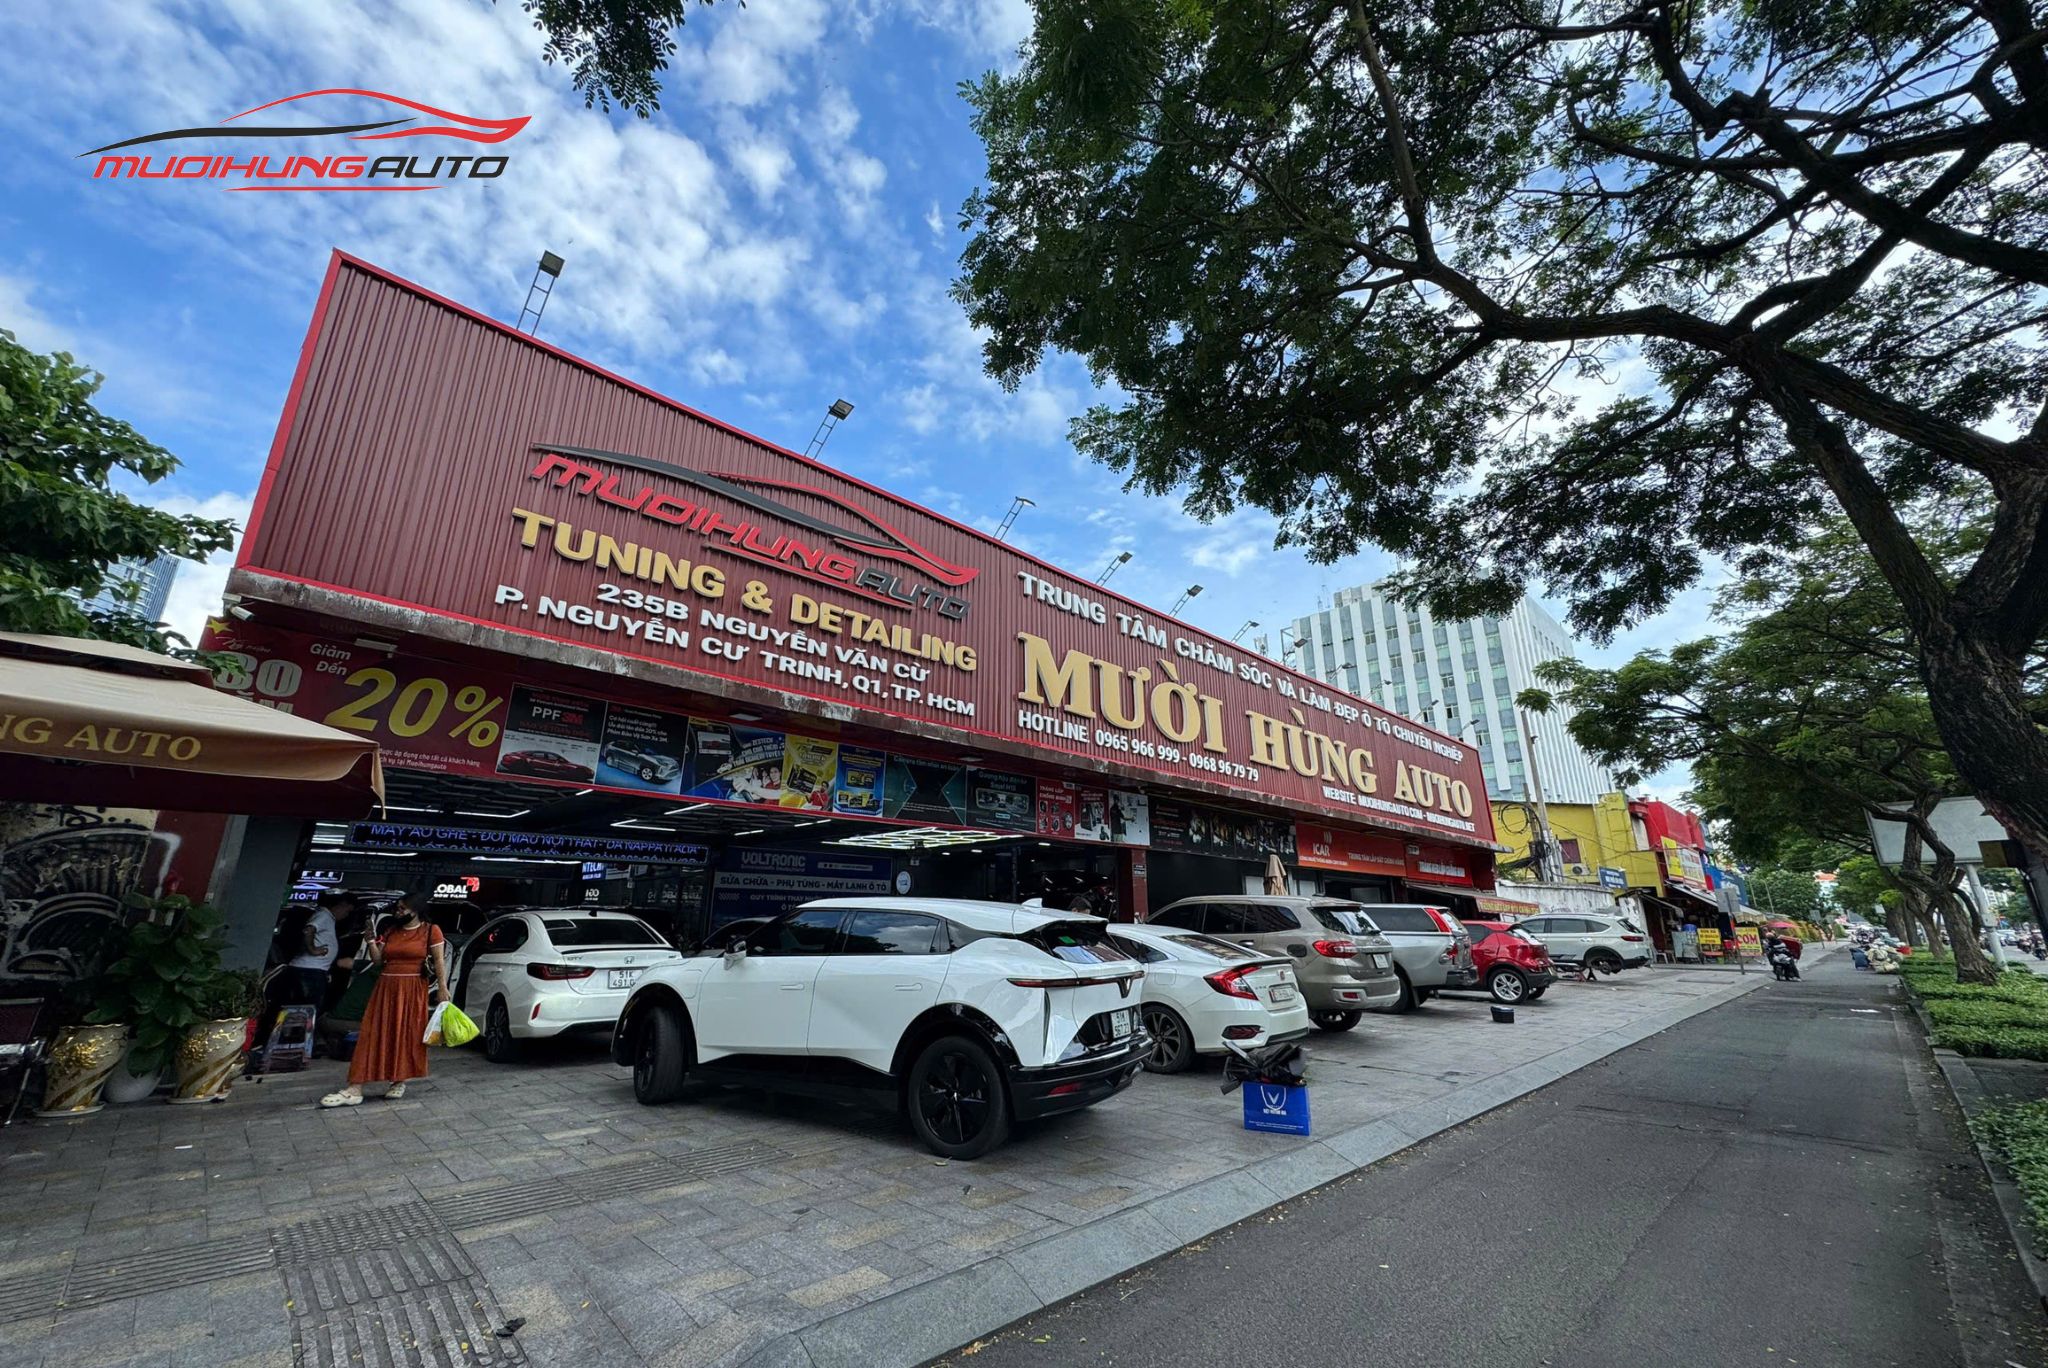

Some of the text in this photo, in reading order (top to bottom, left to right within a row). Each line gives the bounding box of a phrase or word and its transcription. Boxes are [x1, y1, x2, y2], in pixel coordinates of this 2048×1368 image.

[512, 507, 978, 672] TUNING & DETAILING
[494, 584, 529, 611] P.
[537, 595, 690, 649] NGUYỄN
[701, 636, 750, 662] CƯ
[926, 692, 976, 717] HCM
[597, 583, 690, 621] 235B
[700, 609, 828, 658] NGUYỄN
[834, 644, 888, 676] VĂN
[310, 642, 351, 660] Giảm
[316, 660, 347, 676] Đến
[1017, 571, 1107, 625] TRUNG
[1116, 612, 1168, 649] TÂM
[1174, 636, 1234, 674] CHĂM
[1237, 661, 1272, 689] SÓC
[1276, 676, 1298, 700] VÀ
[1333, 698, 1360, 726] ĐẸP
[1361, 706, 1372, 726] Ô
[1373, 713, 1391, 736] TÔ
[1392, 724, 1433, 751] CHUYÊN
[1433, 737, 1465, 764] NGHIỆP
[322, 667, 504, 748] 20%
[531, 706, 561, 721] PPF
[1017, 631, 1474, 818] MƯỜI HÙNG AUTO
[63, 722, 202, 761] AUTO
[1095, 728, 1129, 751] 0965
[1130, 737, 1156, 759] 966
[1157, 743, 1181, 764] 999
[1189, 752, 1217, 773] 0968
[741, 851, 806, 867] VOLTRONIC
[742, 874, 769, 886] CHỮA
[434, 883, 469, 895] OBAL
